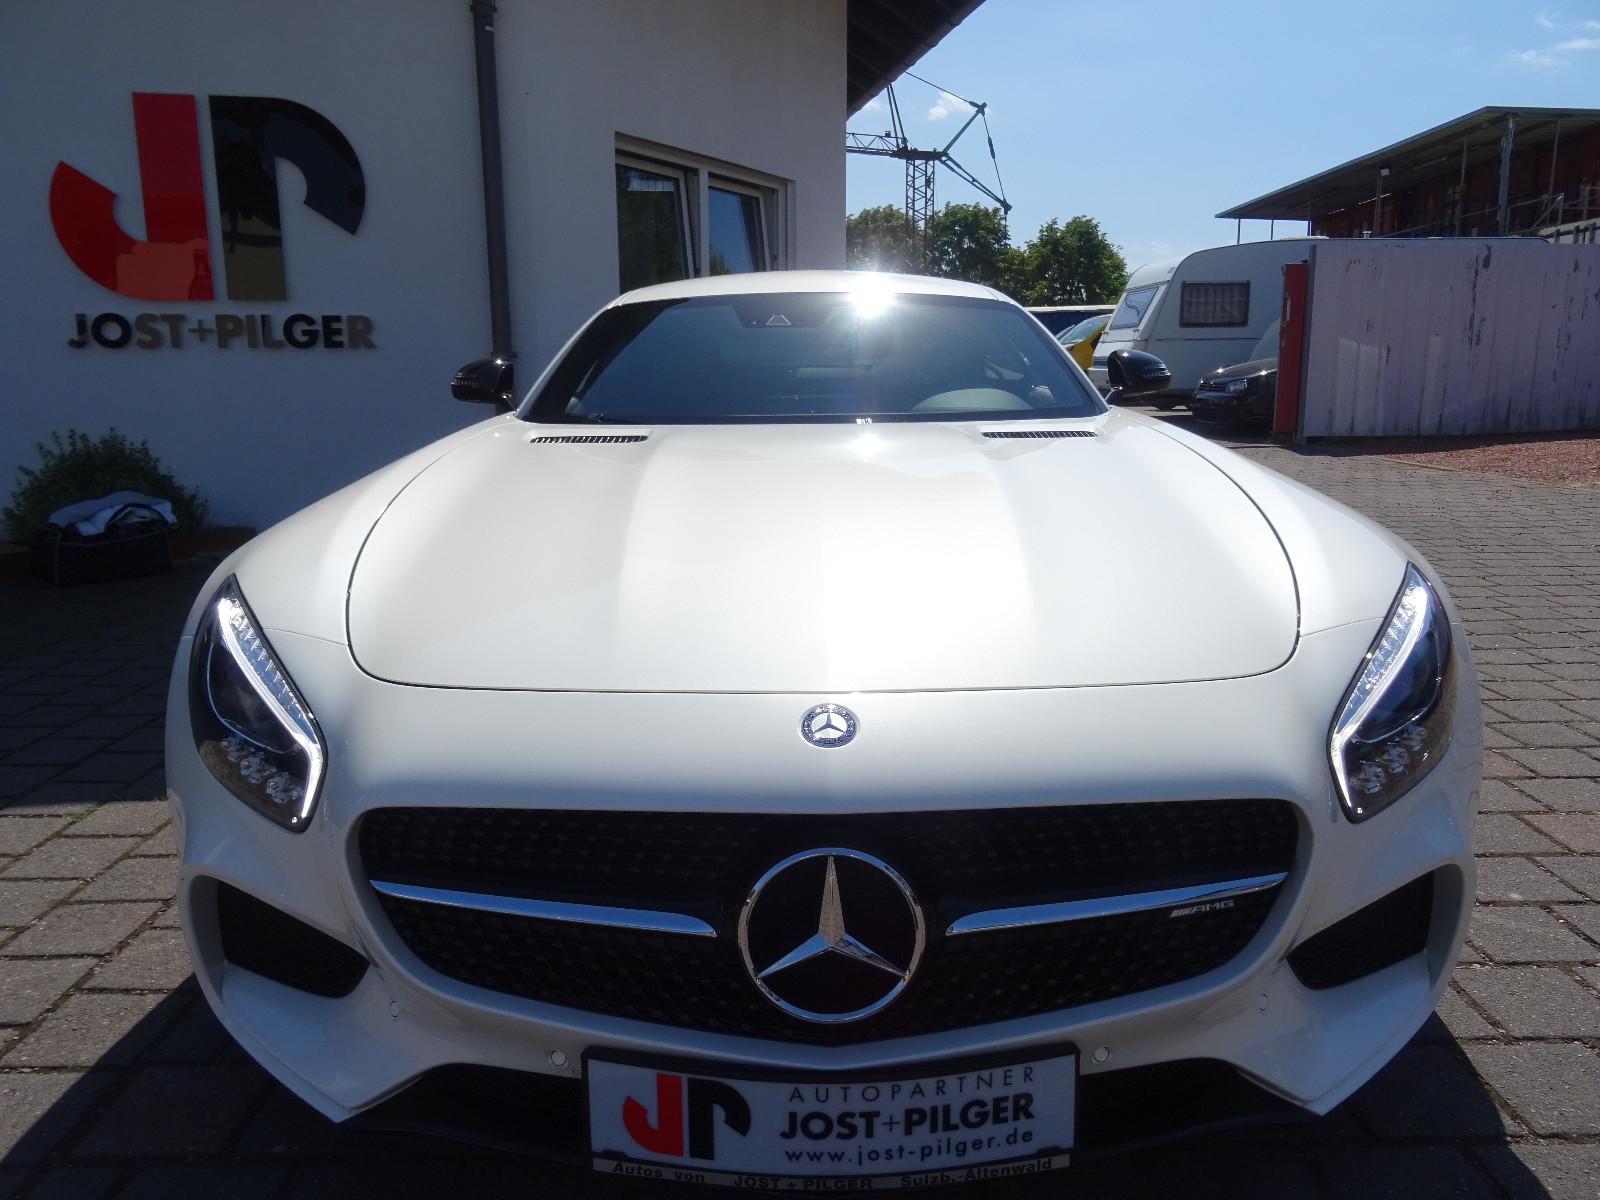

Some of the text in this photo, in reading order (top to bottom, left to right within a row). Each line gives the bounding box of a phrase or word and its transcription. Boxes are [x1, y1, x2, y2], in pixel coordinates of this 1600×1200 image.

[67, 312, 377, 350] JOST+PILGER
[788, 1066, 1034, 1104] AUTOPARTNER
[780, 1092, 1036, 1141] JOST+PILGER
[784, 1128, 1034, 1166] www.jost-pilger.de
[612, 1162, 664, 1179] Autos
[674, 1171, 705, 1184] von
[901, 1157, 1052, 1187] Sulzb.-Altenwald
